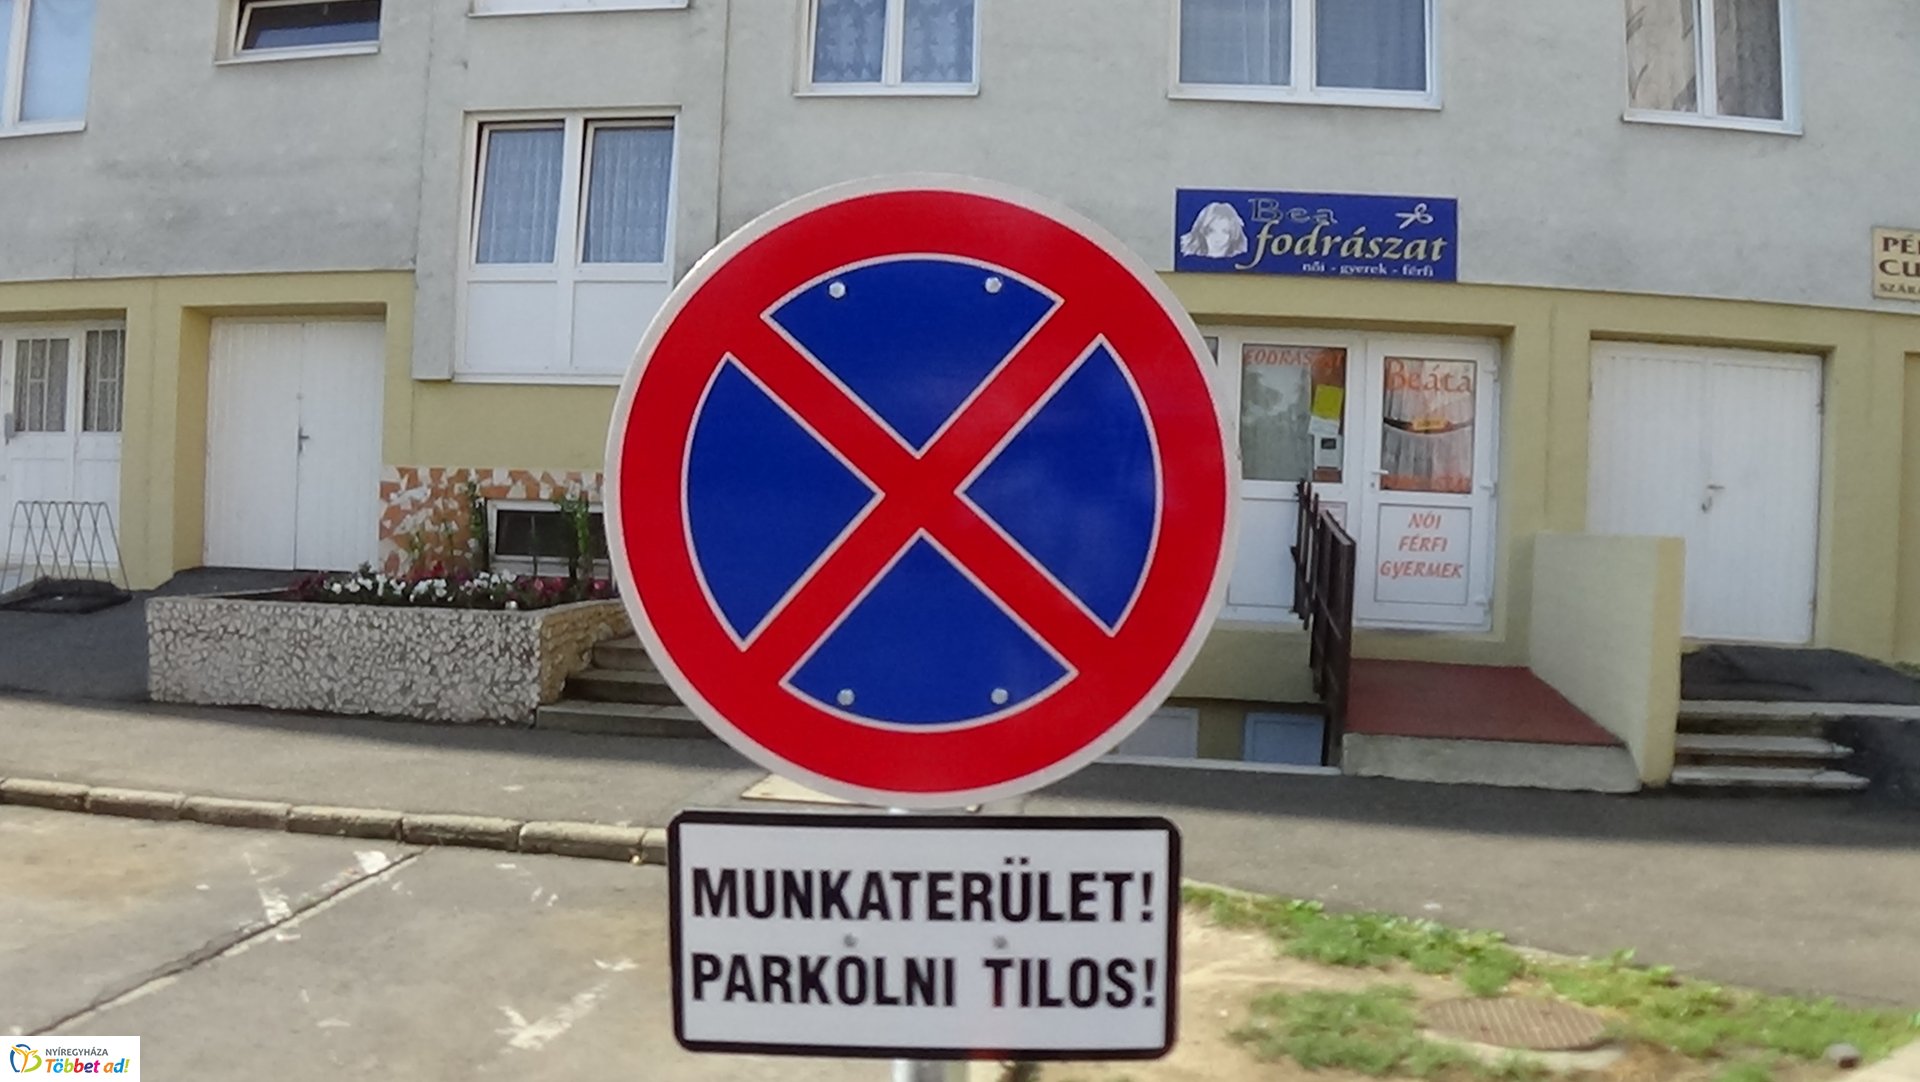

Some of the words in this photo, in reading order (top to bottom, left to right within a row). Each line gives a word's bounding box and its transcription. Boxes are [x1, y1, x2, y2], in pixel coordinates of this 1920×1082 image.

[1248, 198, 1338, 224] Bea
[1235, 219, 1447, 270] fodrászat
[1882, 233, 1920, 255] PÉ
[1340, 263, 1387, 275] gyerek
[1398, 533, 1448, 553] FÉRFI
[1380, 560, 1464, 580] GYERMEK
[691, 857, 1156, 923] MUNKATERÜLET!
[690, 952, 957, 1007] PARKOLNI
[984, 957, 1157, 1008] TILOS!
